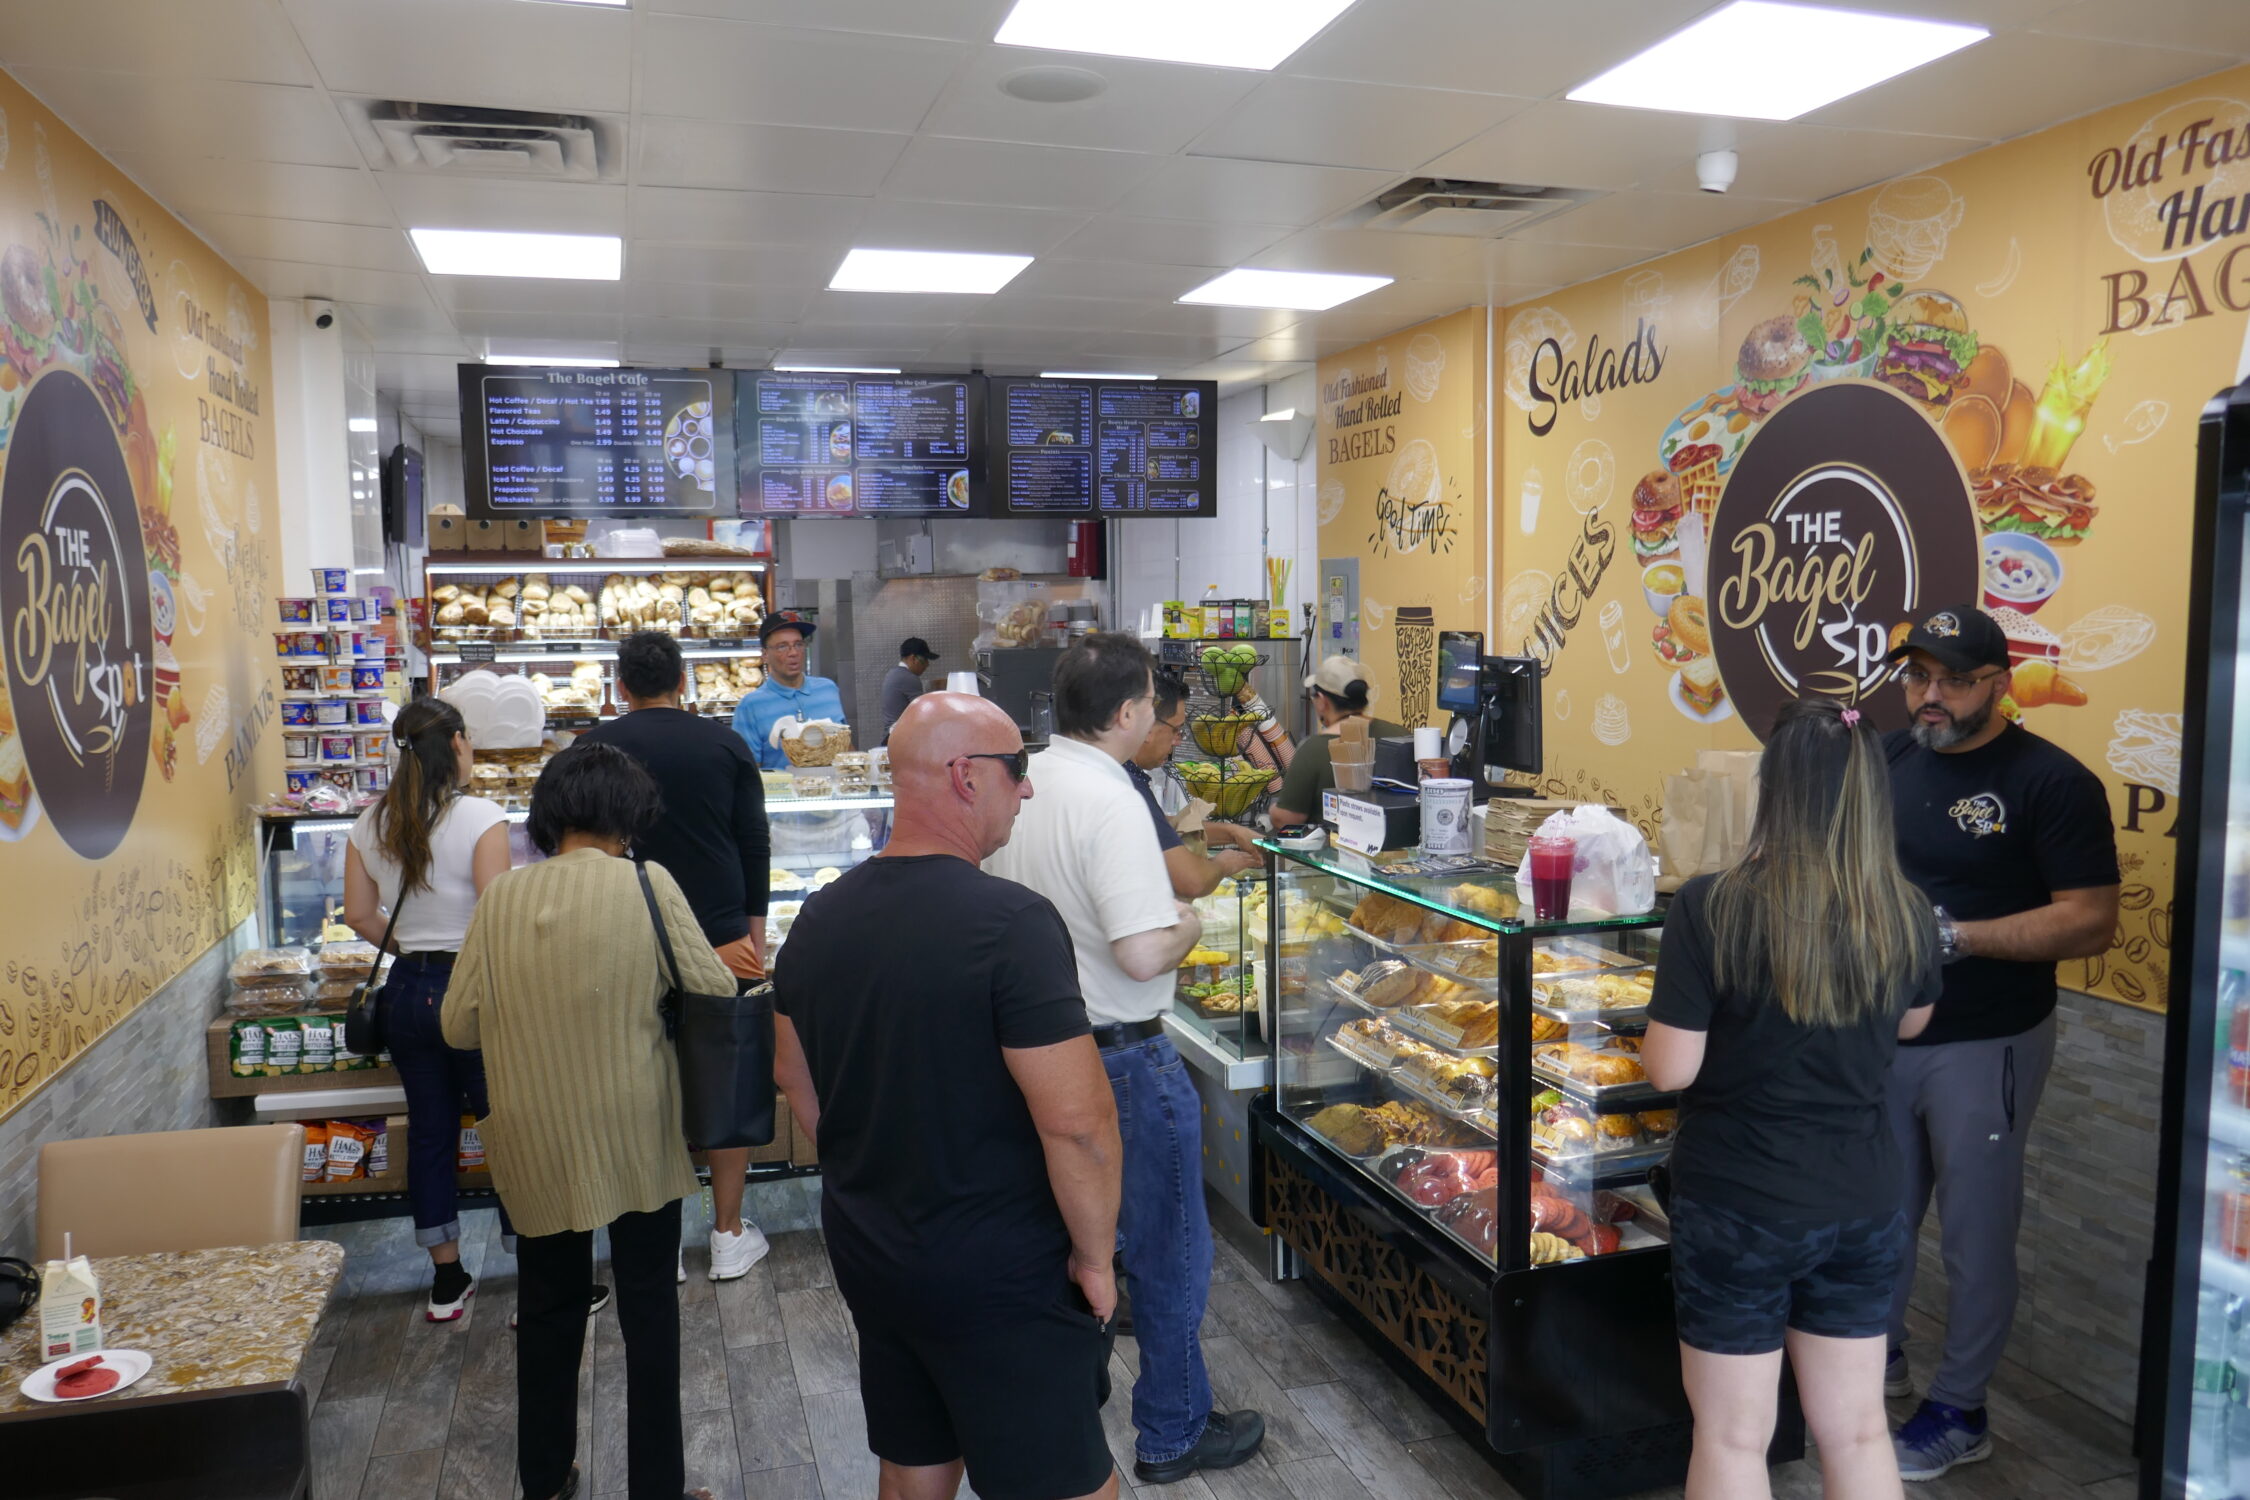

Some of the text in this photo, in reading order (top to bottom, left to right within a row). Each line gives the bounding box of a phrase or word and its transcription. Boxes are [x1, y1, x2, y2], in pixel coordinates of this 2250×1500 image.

[2087, 134, 2168, 199] Old
[185, 299, 203, 341] Old
[206, 355, 233, 403] Hand
[547, 373, 649, 386] The Bagel Cafe
[1323, 367, 1388, 404] Old Fashioned
[1528, 317, 1668, 437] Salads
[198, 396, 255, 461] BAGELS
[489, 407, 522, 415] Flavored
[517, 418, 560, 426] Cappuccino
[1335, 392, 1402, 431] Hand Rolled
[491, 438, 525, 446] Espresso
[1328, 424, 1396, 466] BAGELS
[1376, 487, 1450, 554] Good Time
[1786, 511, 1842, 545] THE
[55, 526, 91, 568] THE
[1520, 504, 1616, 679] UICES
[1719, 523, 1877, 651] Bagel
[13, 533, 113, 705] Bagel
[86, 652, 146, 728] Spot
[1948, 799, 1995, 824] Bagel
[1975, 819, 2006, 833] Spot
[2121, 782, 2178, 838] P
